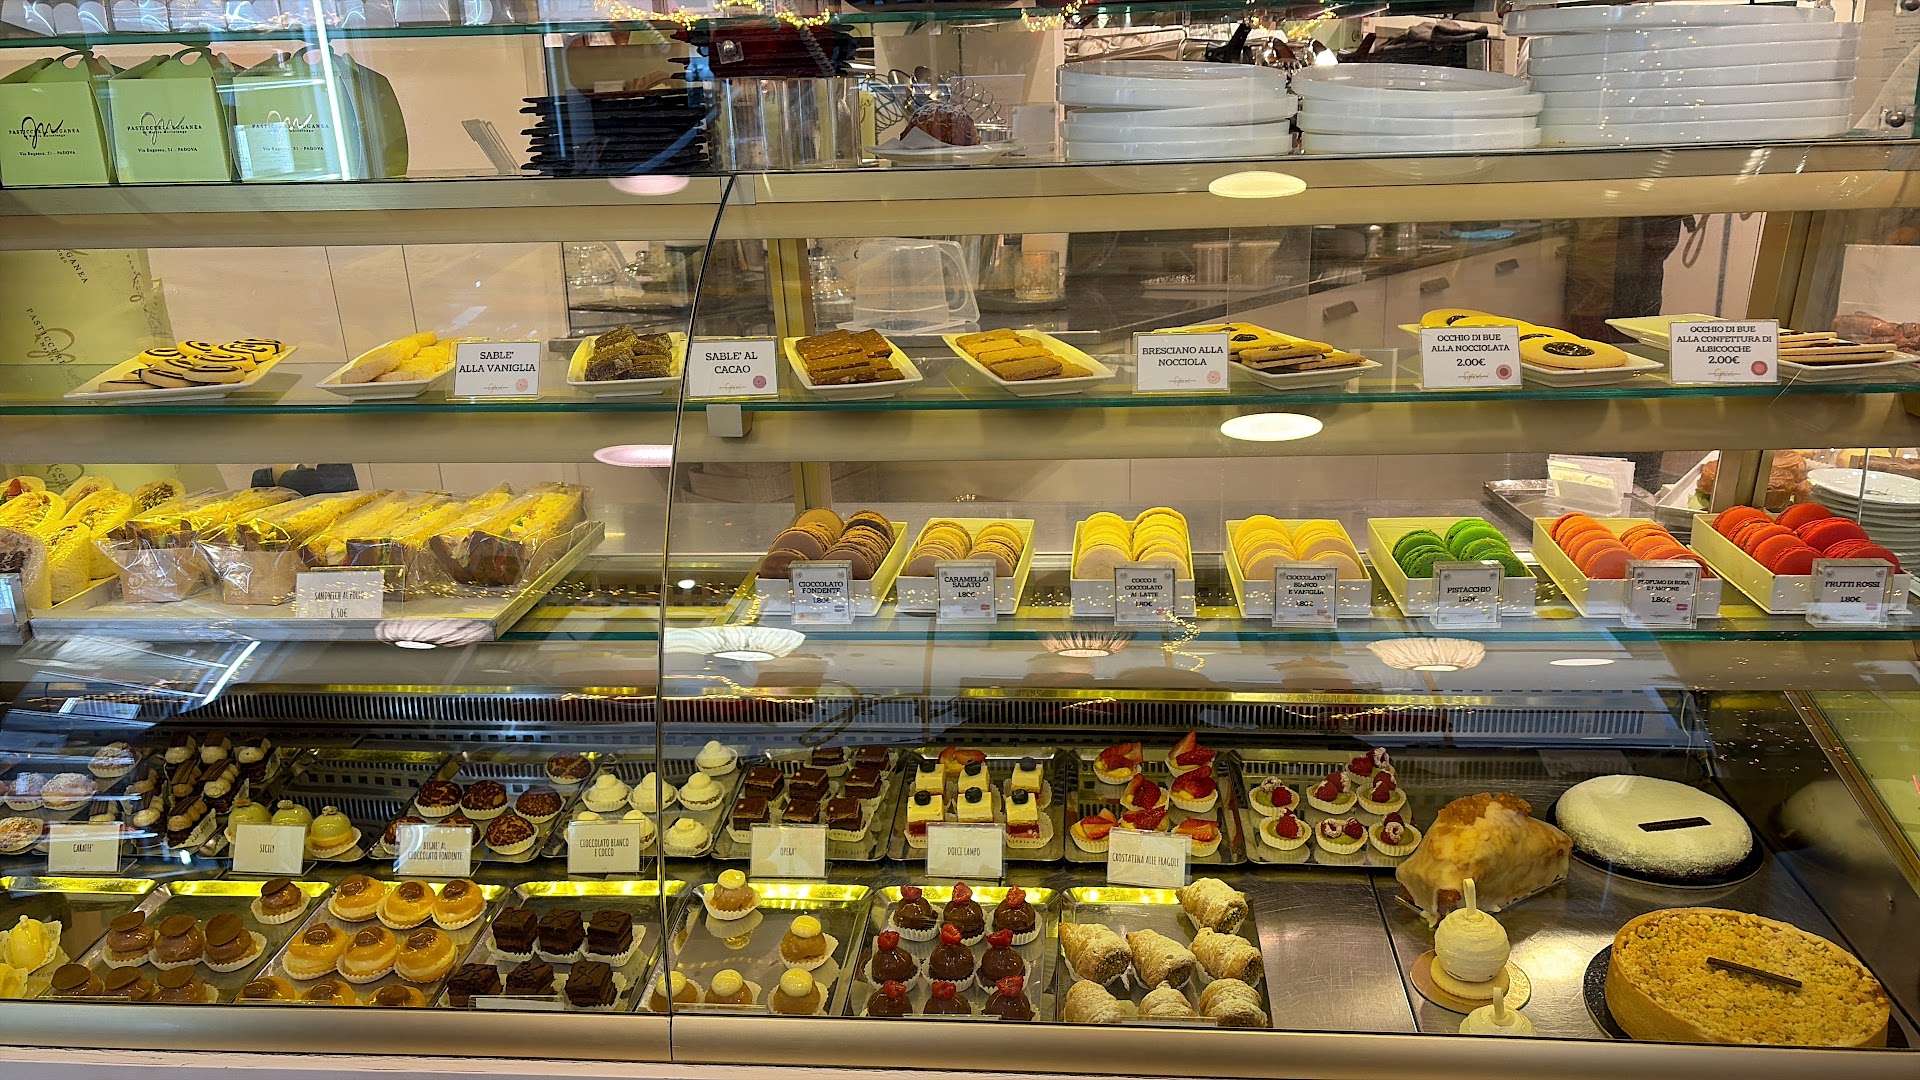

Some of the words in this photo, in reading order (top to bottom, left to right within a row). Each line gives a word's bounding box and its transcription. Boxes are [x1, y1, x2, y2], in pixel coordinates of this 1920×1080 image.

[1737, 325, 1756, 333] BUE
[1437, 334, 1470, 342] OCCHIO
[1482, 333, 1501, 341] BUE
[1700, 335, 1761, 343] CONFETTURA
[1762, 335, 1772, 343] DI
[1142, 346, 1197, 355] BRESCIANO
[1198, 346, 1224, 354] ALLA
[1455, 344, 1510, 352] NOCCIOLATA
[1695, 345, 1751, 353] ALBICOCCHE
[480, 351, 514, 360] SABLE'
[705, 352, 742, 361] SABLE'
[744, 351, 758, 360] AL
[1708, 355, 1740, 364] 2.00€
[1158, 358, 1207, 366] NOCCIOLA
[1456, 358, 1486, 367] 2.00€
[459, 364, 485, 373] ALLA
[486, 363, 536, 372] VANIGLIA
[714, 364, 751, 374] CACAO
[314, 591, 341, 600] SANDWICH
[342, 591, 349, 600] AL
[580, 838, 610, 848] CIOCCOLATO
[610, 837, 630, 848] BIANCO
[259, 844, 275, 853] SICILY
[598, 847, 615, 857] COCCO
[947, 846, 963, 856] DOLCE
[963, 847, 981, 857] LAMPO
[408, 851, 438, 860] CIOCCOLATO
[439, 851, 462, 861] FONDENTE
[1112, 852, 1144, 864] CROSTATINA
[1145, 855, 1157, 866] ALLE
[1157, 856, 1179, 867] FRAGOLE
